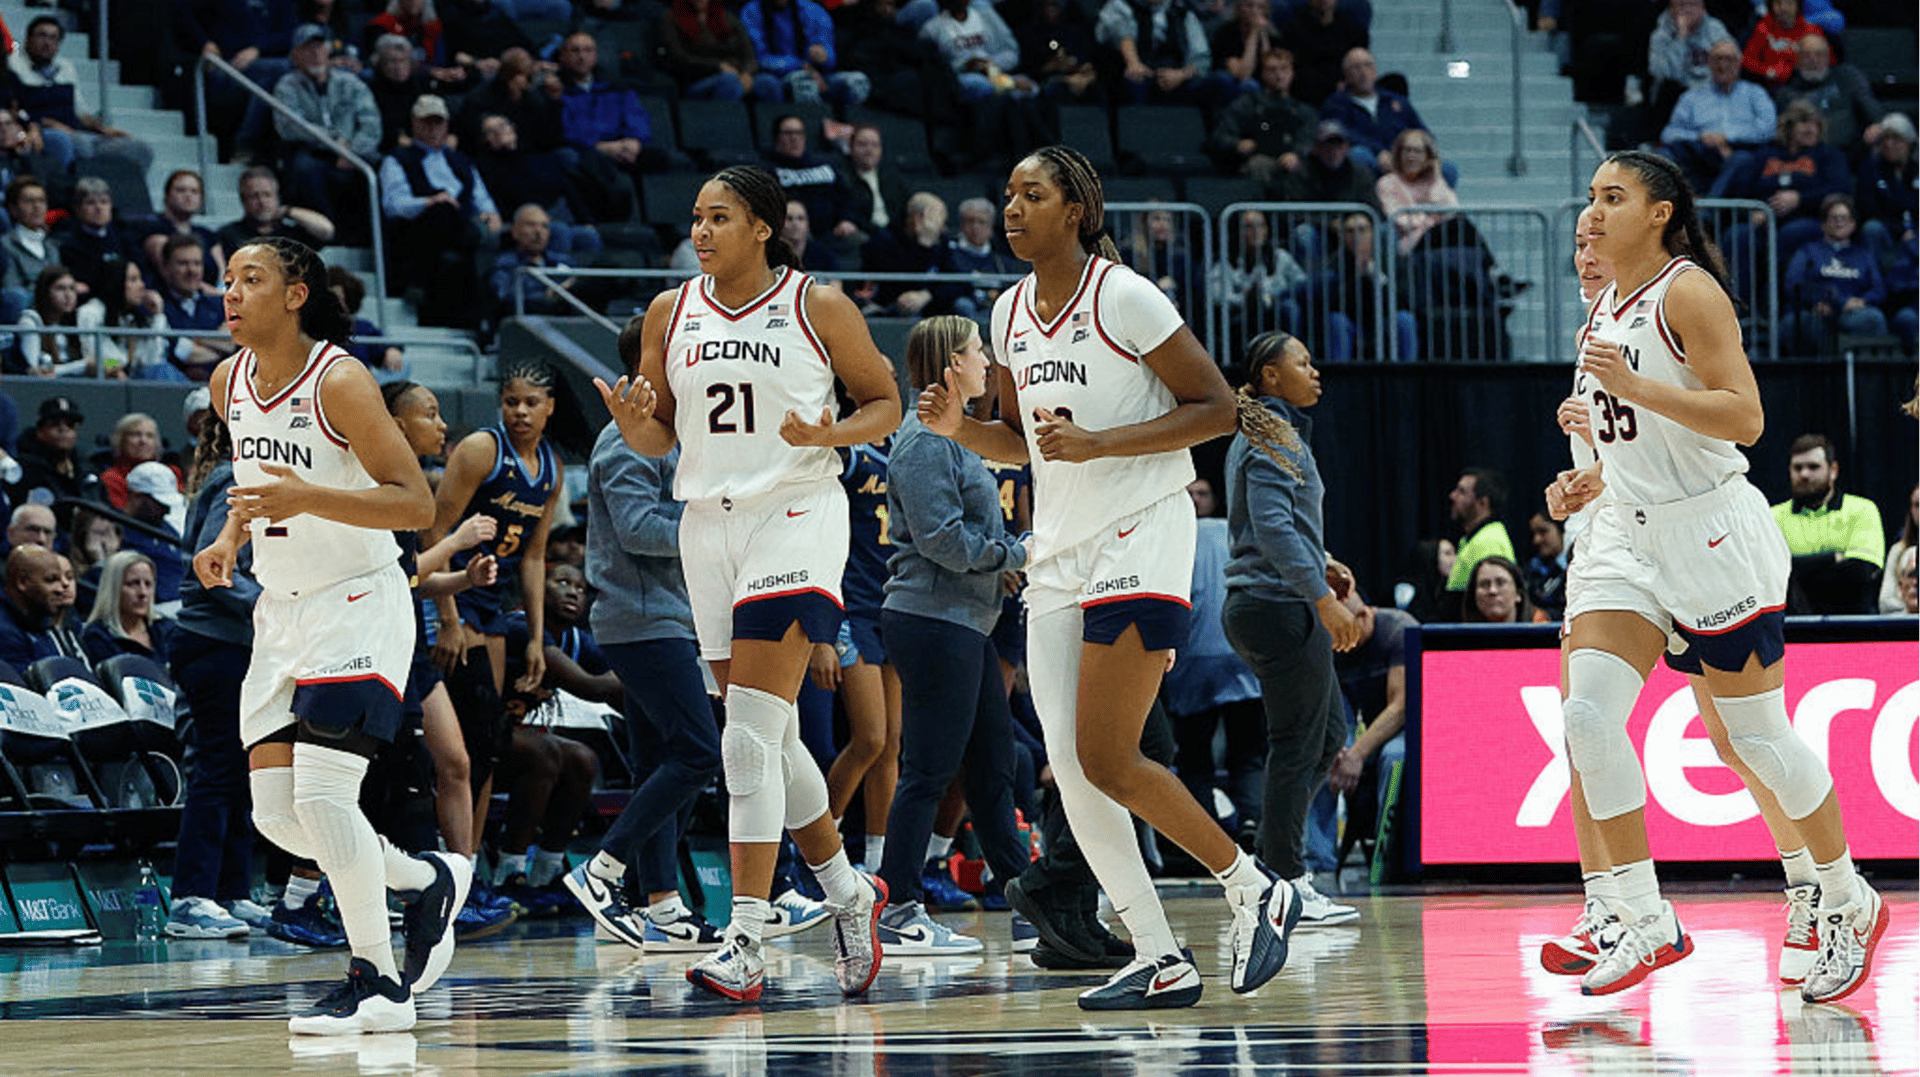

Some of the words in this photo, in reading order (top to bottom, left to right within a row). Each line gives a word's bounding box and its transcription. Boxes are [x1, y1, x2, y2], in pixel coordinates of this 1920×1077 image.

[686, 340, 780, 368] UCONN
[1018, 360, 1087, 390] UCONN
[706, 382, 755, 434] 21
[1593, 390, 1638, 443] 35
[496, 524, 524, 558] 5
[747, 569, 809, 592] HUSKIES
[1087, 575, 1140, 595] USKIES
[1695, 595, 1757, 629] HUSKIES
[18, 899, 50, 922] M&T
[49, 897, 82, 920] Bank
